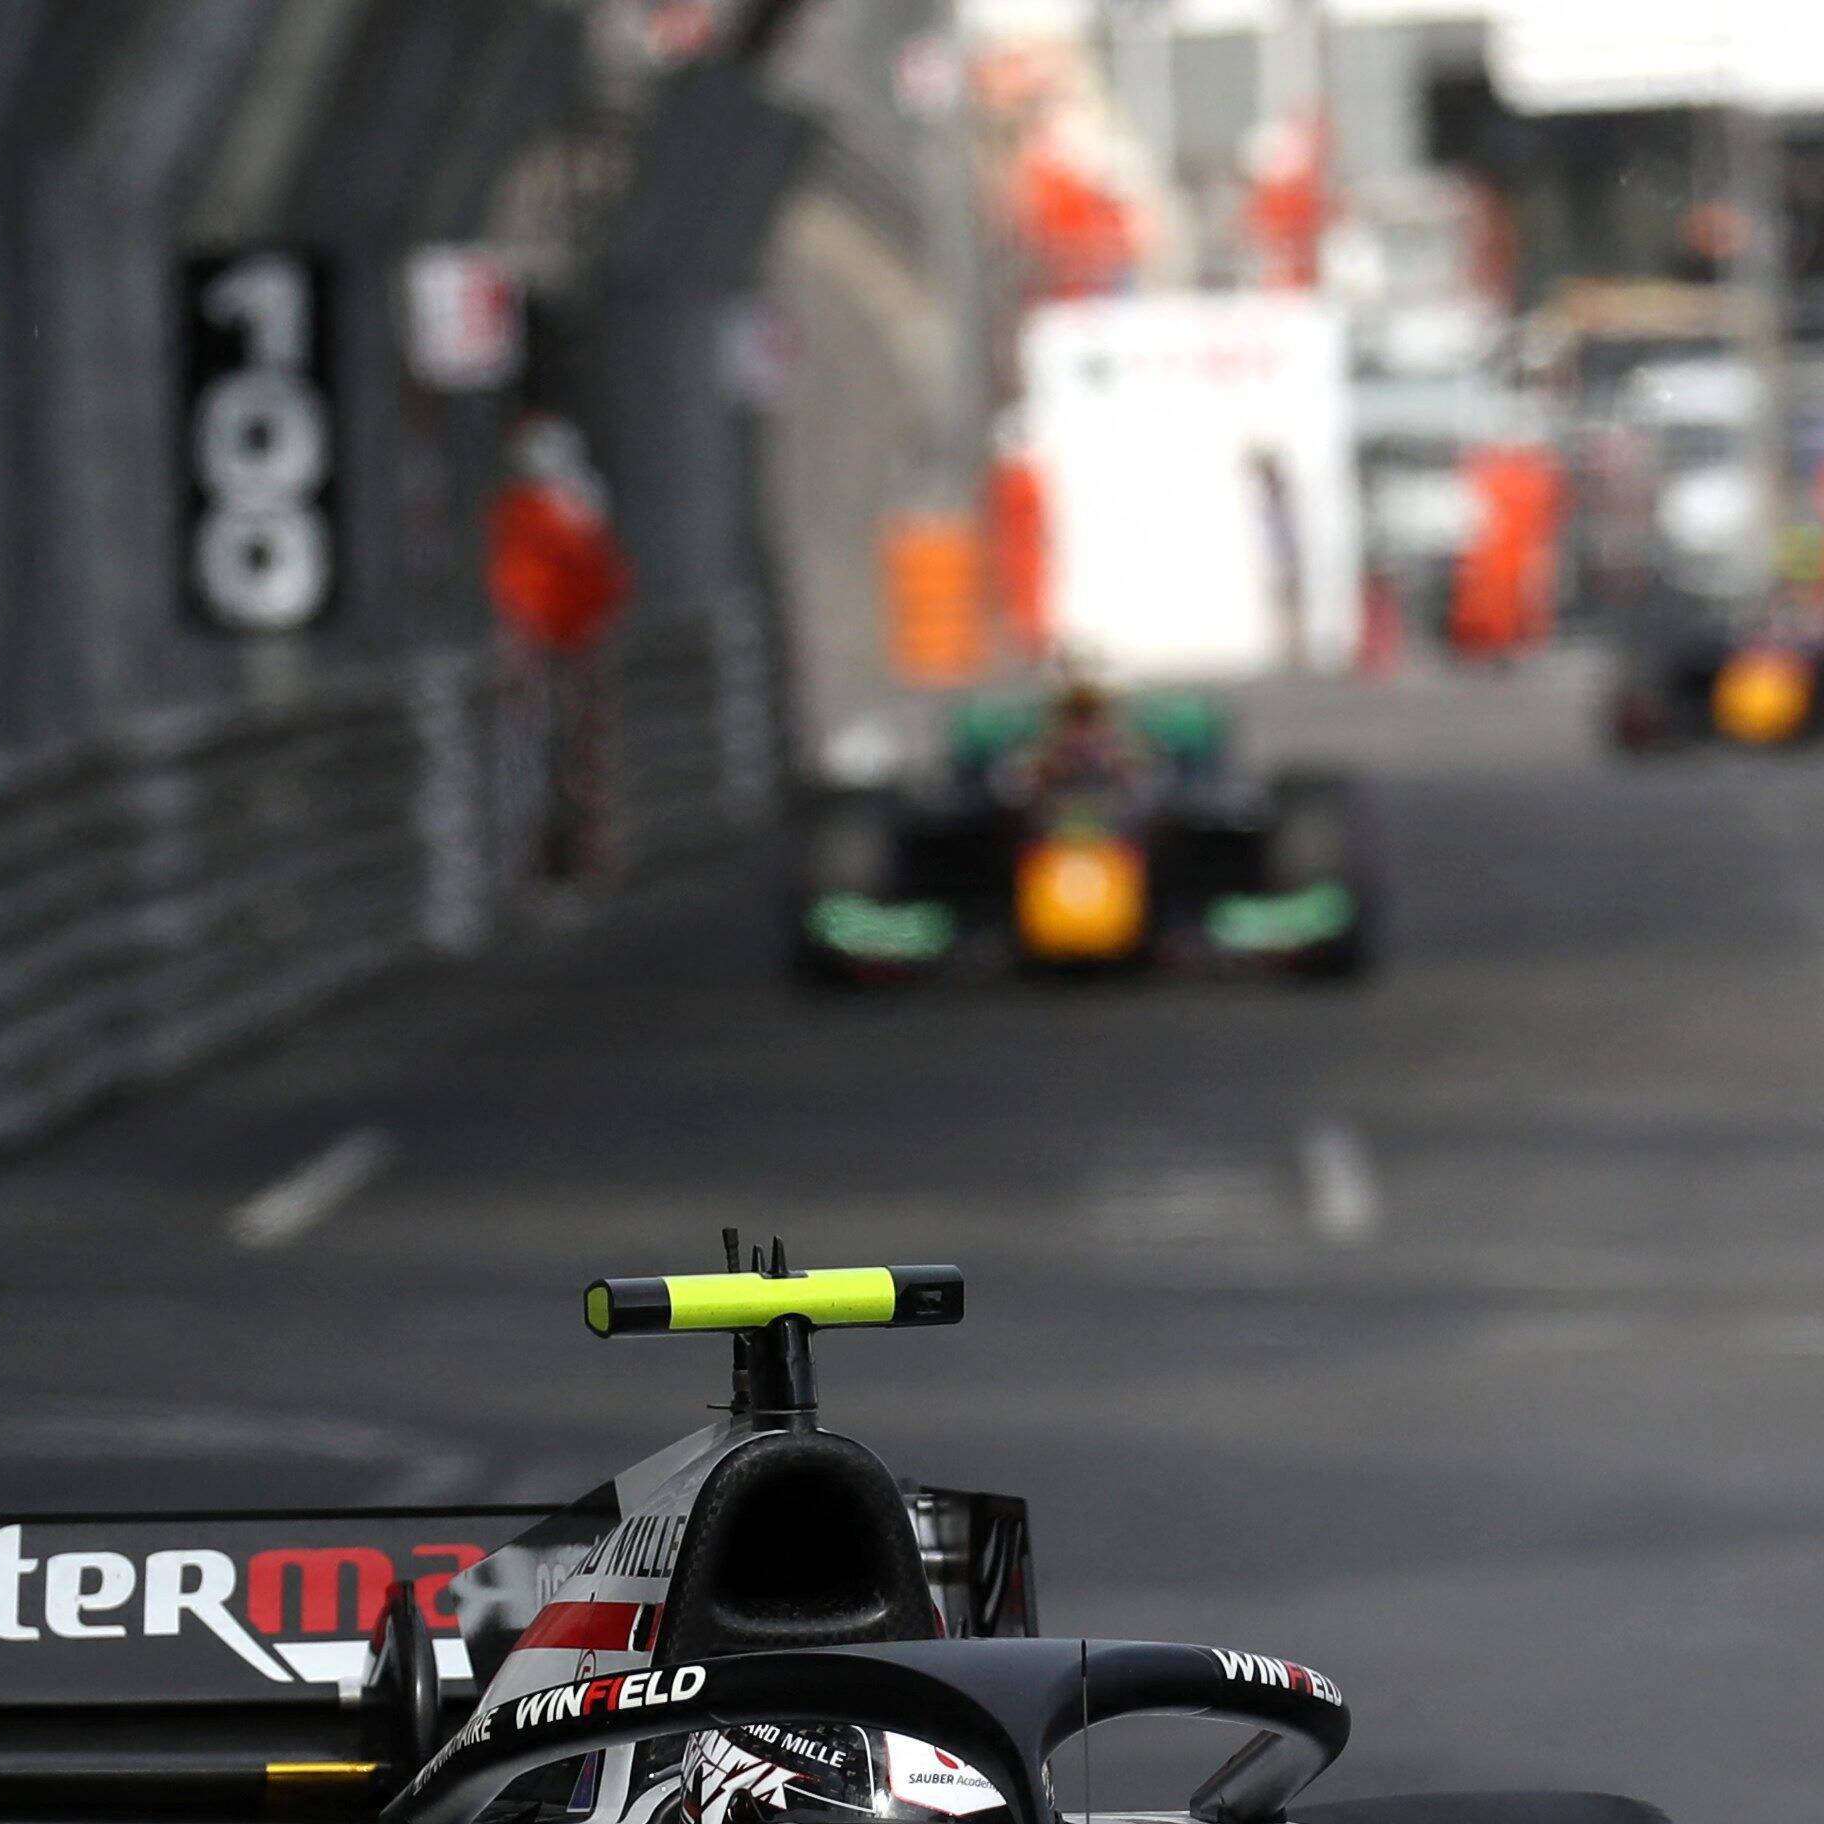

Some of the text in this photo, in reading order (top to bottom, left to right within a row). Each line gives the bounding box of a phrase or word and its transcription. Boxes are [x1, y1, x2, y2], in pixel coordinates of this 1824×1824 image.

[196, 256, 332, 630] 100
[515, 1665, 707, 1730] WINFIELD
[1211, 1648, 1343, 1707] WINFIELD
[780, 1732, 847, 1768] MILLE
[908, 1773, 997, 1791] SAUBER Academ
